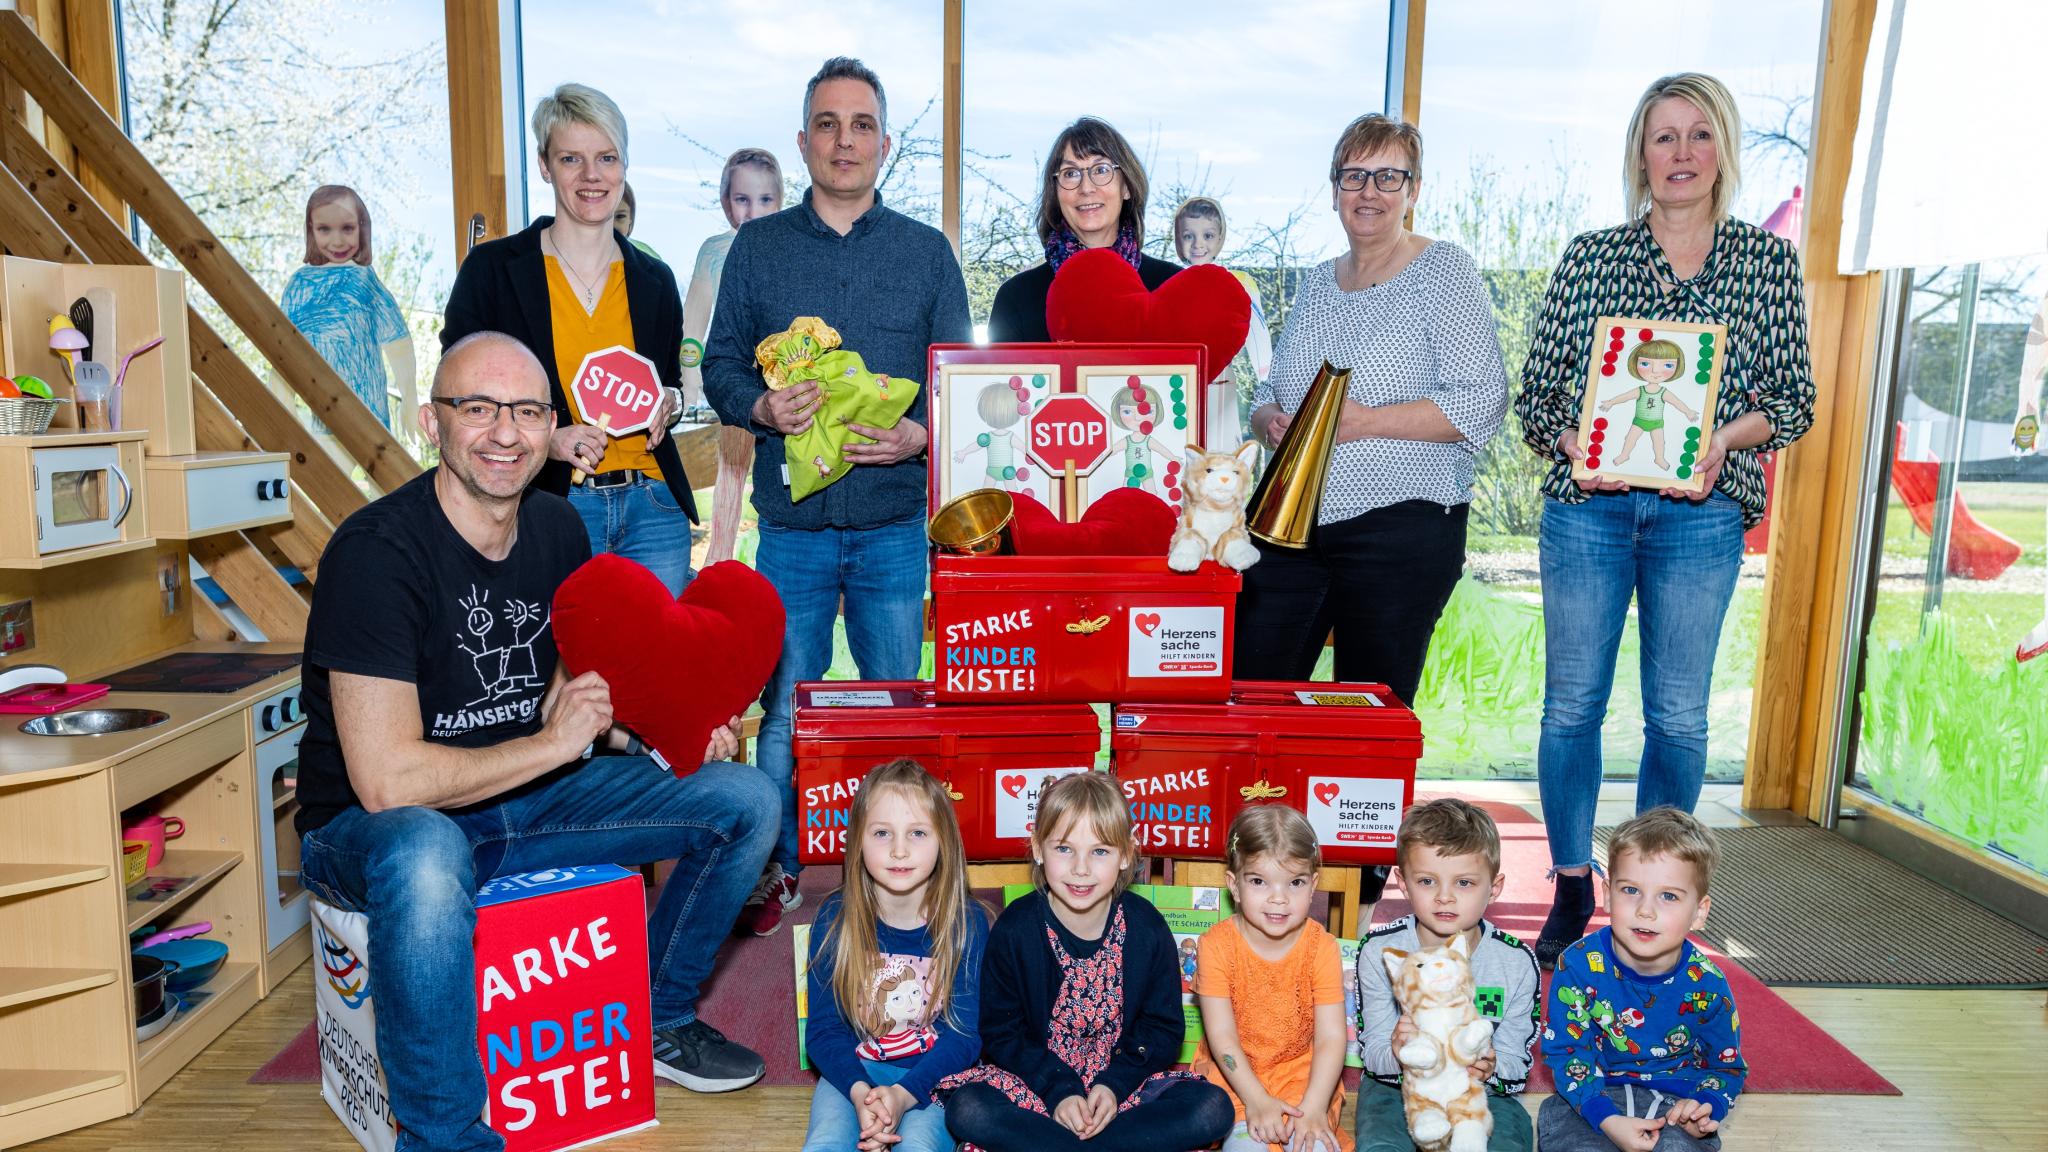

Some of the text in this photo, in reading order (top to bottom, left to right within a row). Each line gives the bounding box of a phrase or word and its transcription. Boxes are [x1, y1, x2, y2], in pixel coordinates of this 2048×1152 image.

[584, 365, 654, 413] STOP
[1035, 421, 1103, 447] STOP
[946, 609, 1033, 644] STARKE
[1161, 629, 1217, 639] Herzens
[946, 646, 1036, 666] KINDER
[1161, 640, 1200, 650] sache
[947, 668, 1035, 692] KISTE!
[805, 775, 867, 806] STAR
[1123, 768, 1209, 798] STARKE
[807, 808, 849, 828] KIN
[1129, 802, 1211, 824] KINDER
[1339, 799, 1396, 811] Herzens
[1339, 810, 1379, 821] sache
[808, 830, 847, 854] KIS
[1130, 823, 1209, 848] KISTE!
[483, 916, 617, 1012] ARKE
[325, 1011, 381, 1086] DEUTSCHER
[487, 1002, 631, 1075] NDER
[320, 1036, 394, 1129] KINDERSCHUTZ
[500, 1050, 631, 1132] STE!
[341, 1084, 368, 1131] PREIS
